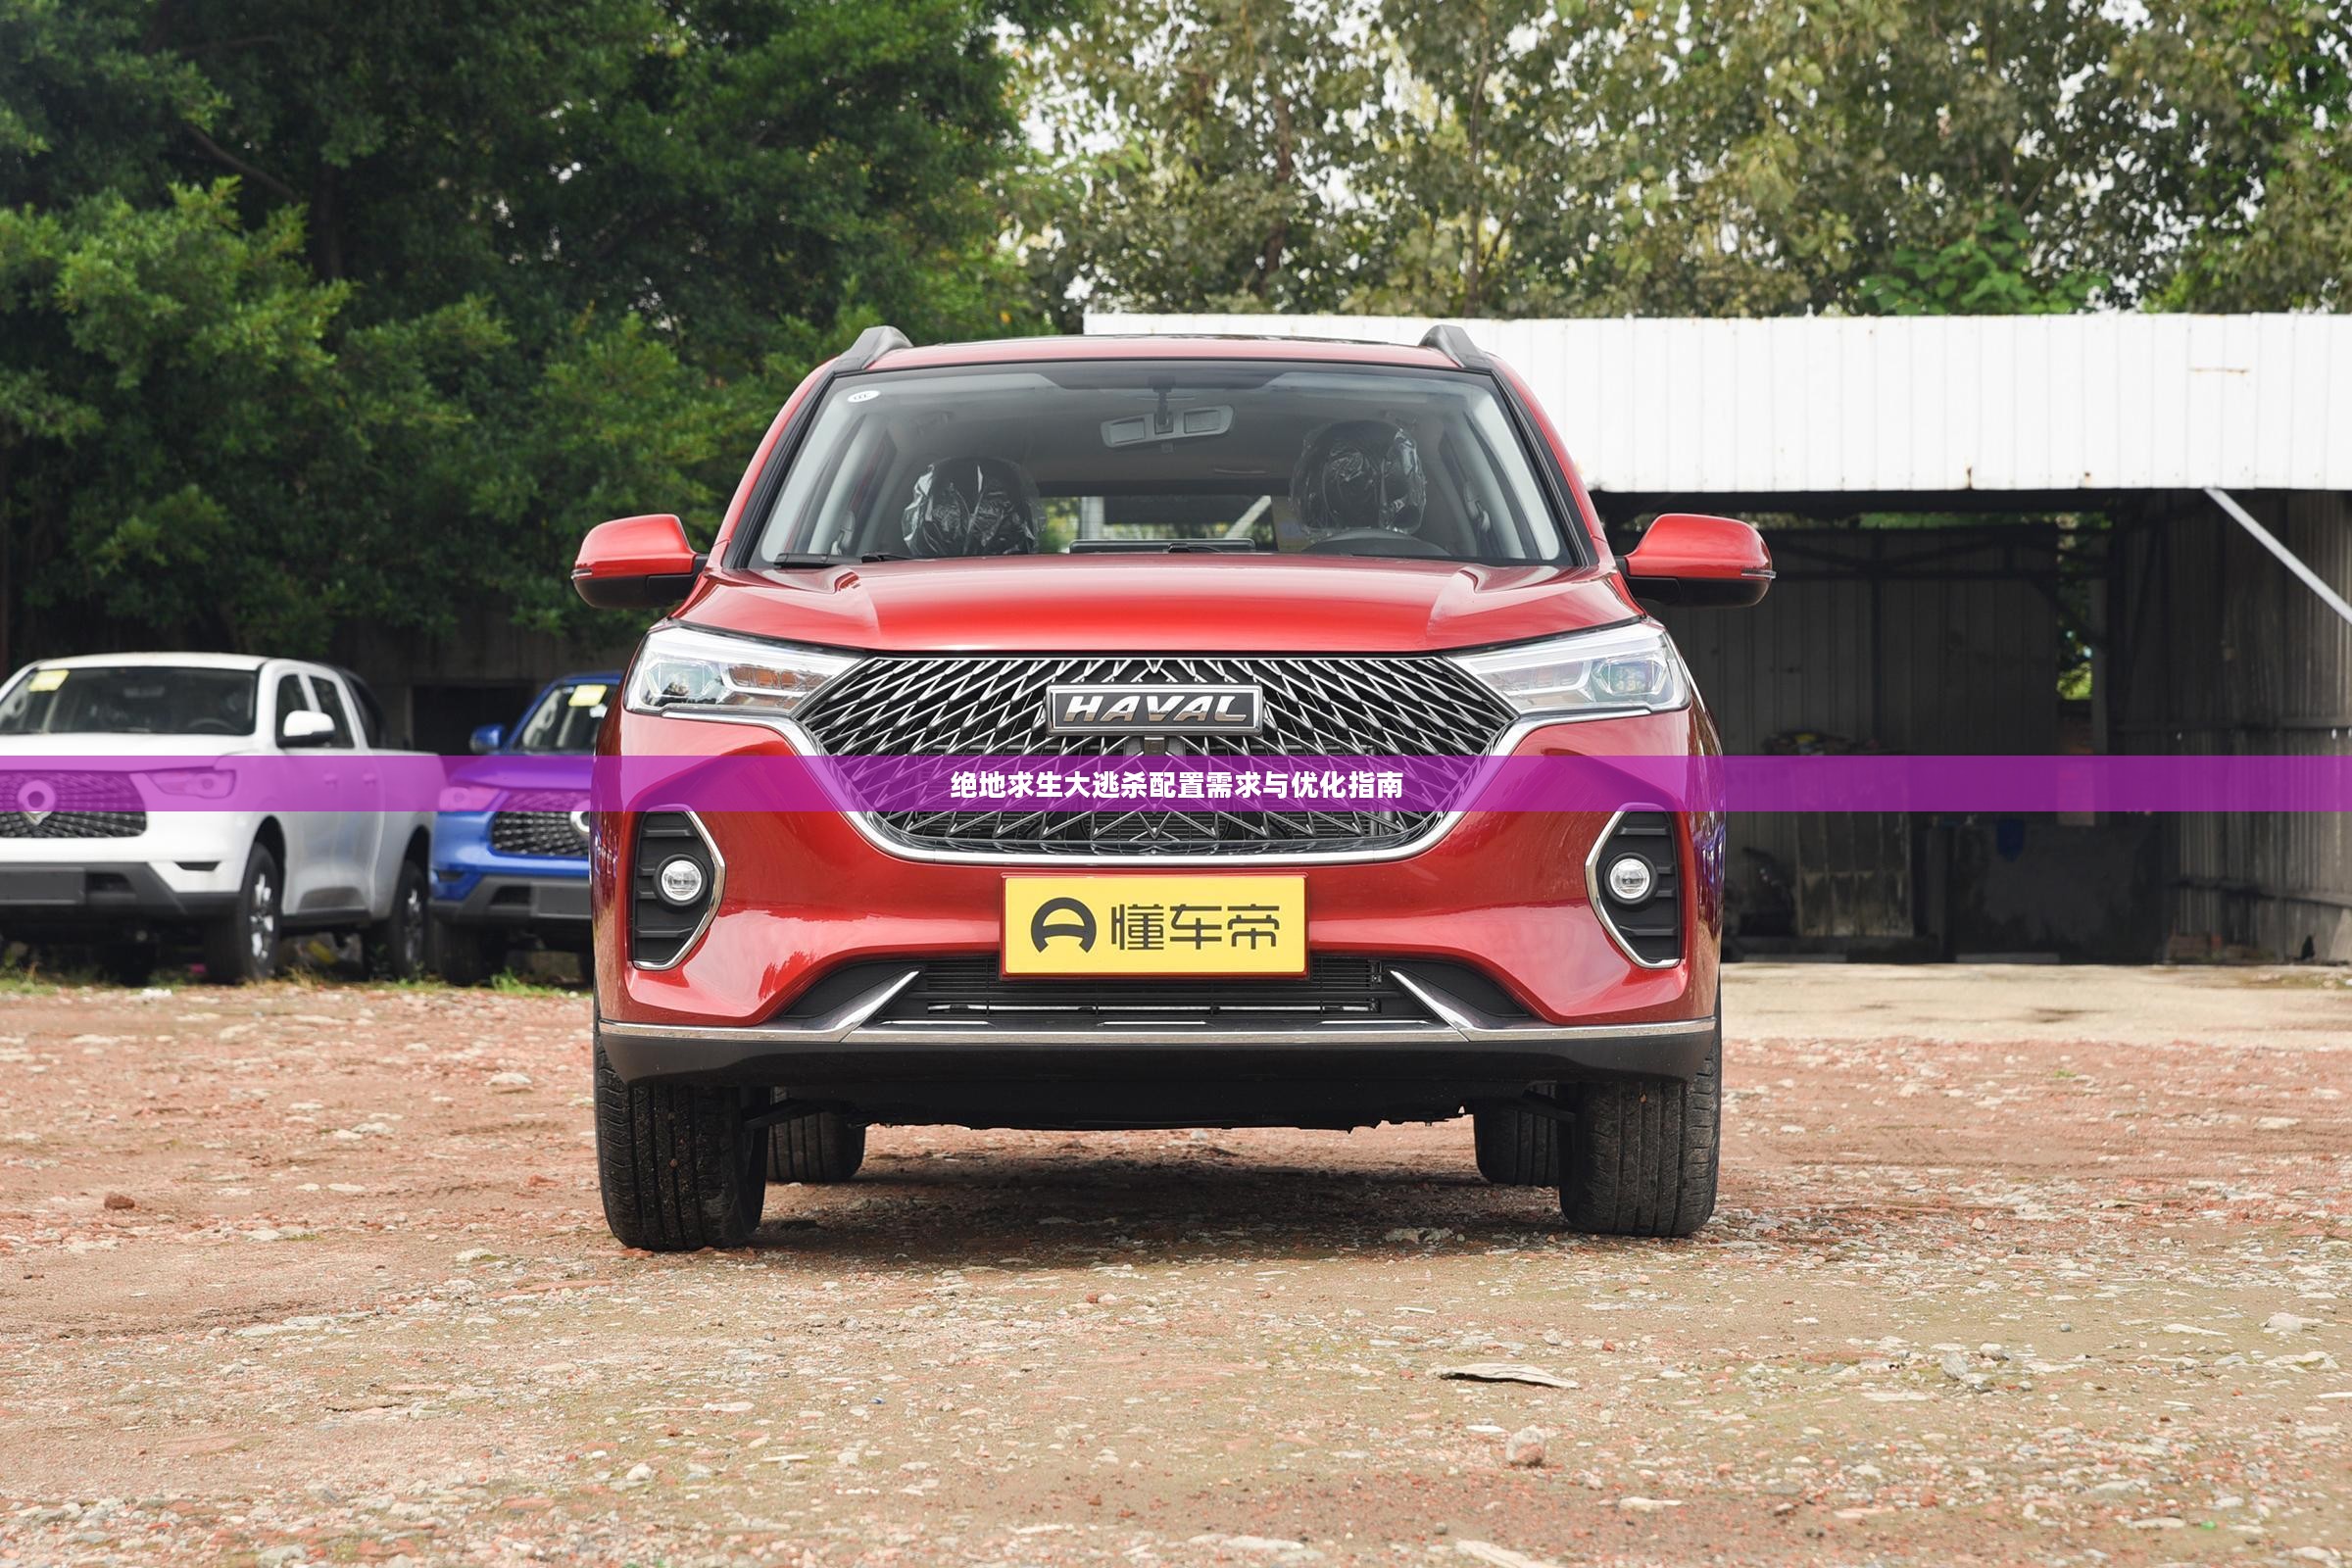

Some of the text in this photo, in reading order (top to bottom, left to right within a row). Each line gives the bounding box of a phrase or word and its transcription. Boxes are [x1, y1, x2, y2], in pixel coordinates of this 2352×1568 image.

[1063, 695, 1247, 722] HAVAL
[1110, 903, 1280, 951] 懂车帝
